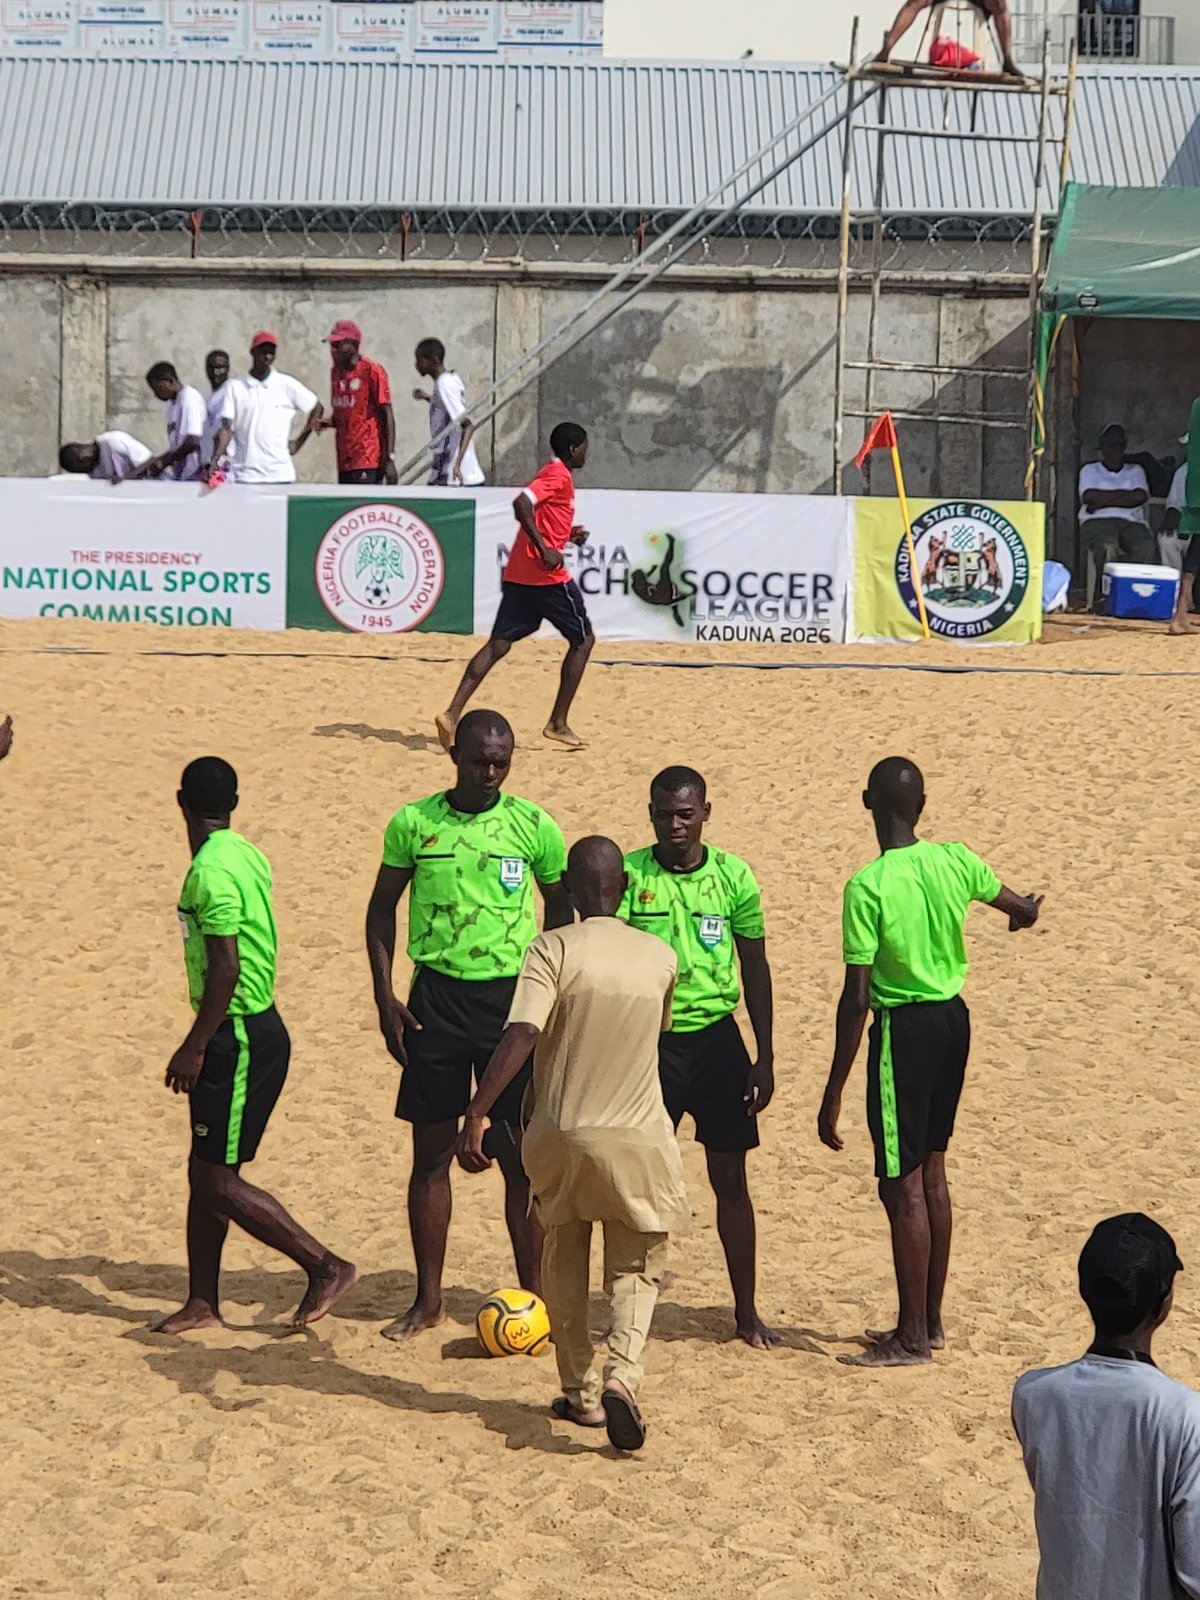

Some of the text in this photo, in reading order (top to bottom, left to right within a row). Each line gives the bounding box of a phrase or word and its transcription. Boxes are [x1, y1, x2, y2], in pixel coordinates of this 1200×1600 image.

[332, 511, 404, 544] FOOTBALL
[71, 550, 202, 565] THE PRESIDENCY
[922, 504, 966, 527] STATE
[970, 506, 1027, 587] GOVERNMENT
[3, 567, 271, 595] NATIONAL SPORTS
[323, 546, 344, 607] NIGERIA
[405, 522, 436, 614] FEDERATION
[680, 570, 834, 600] SOCCER
[40, 603, 232, 627] COMMISSION
[361, 614, 393, 627] 1945
[689, 595, 830, 624] LEAGUE
[696, 625, 831, 644] KADUNA 2026
[929, 617, 993, 636] NIGERIA
